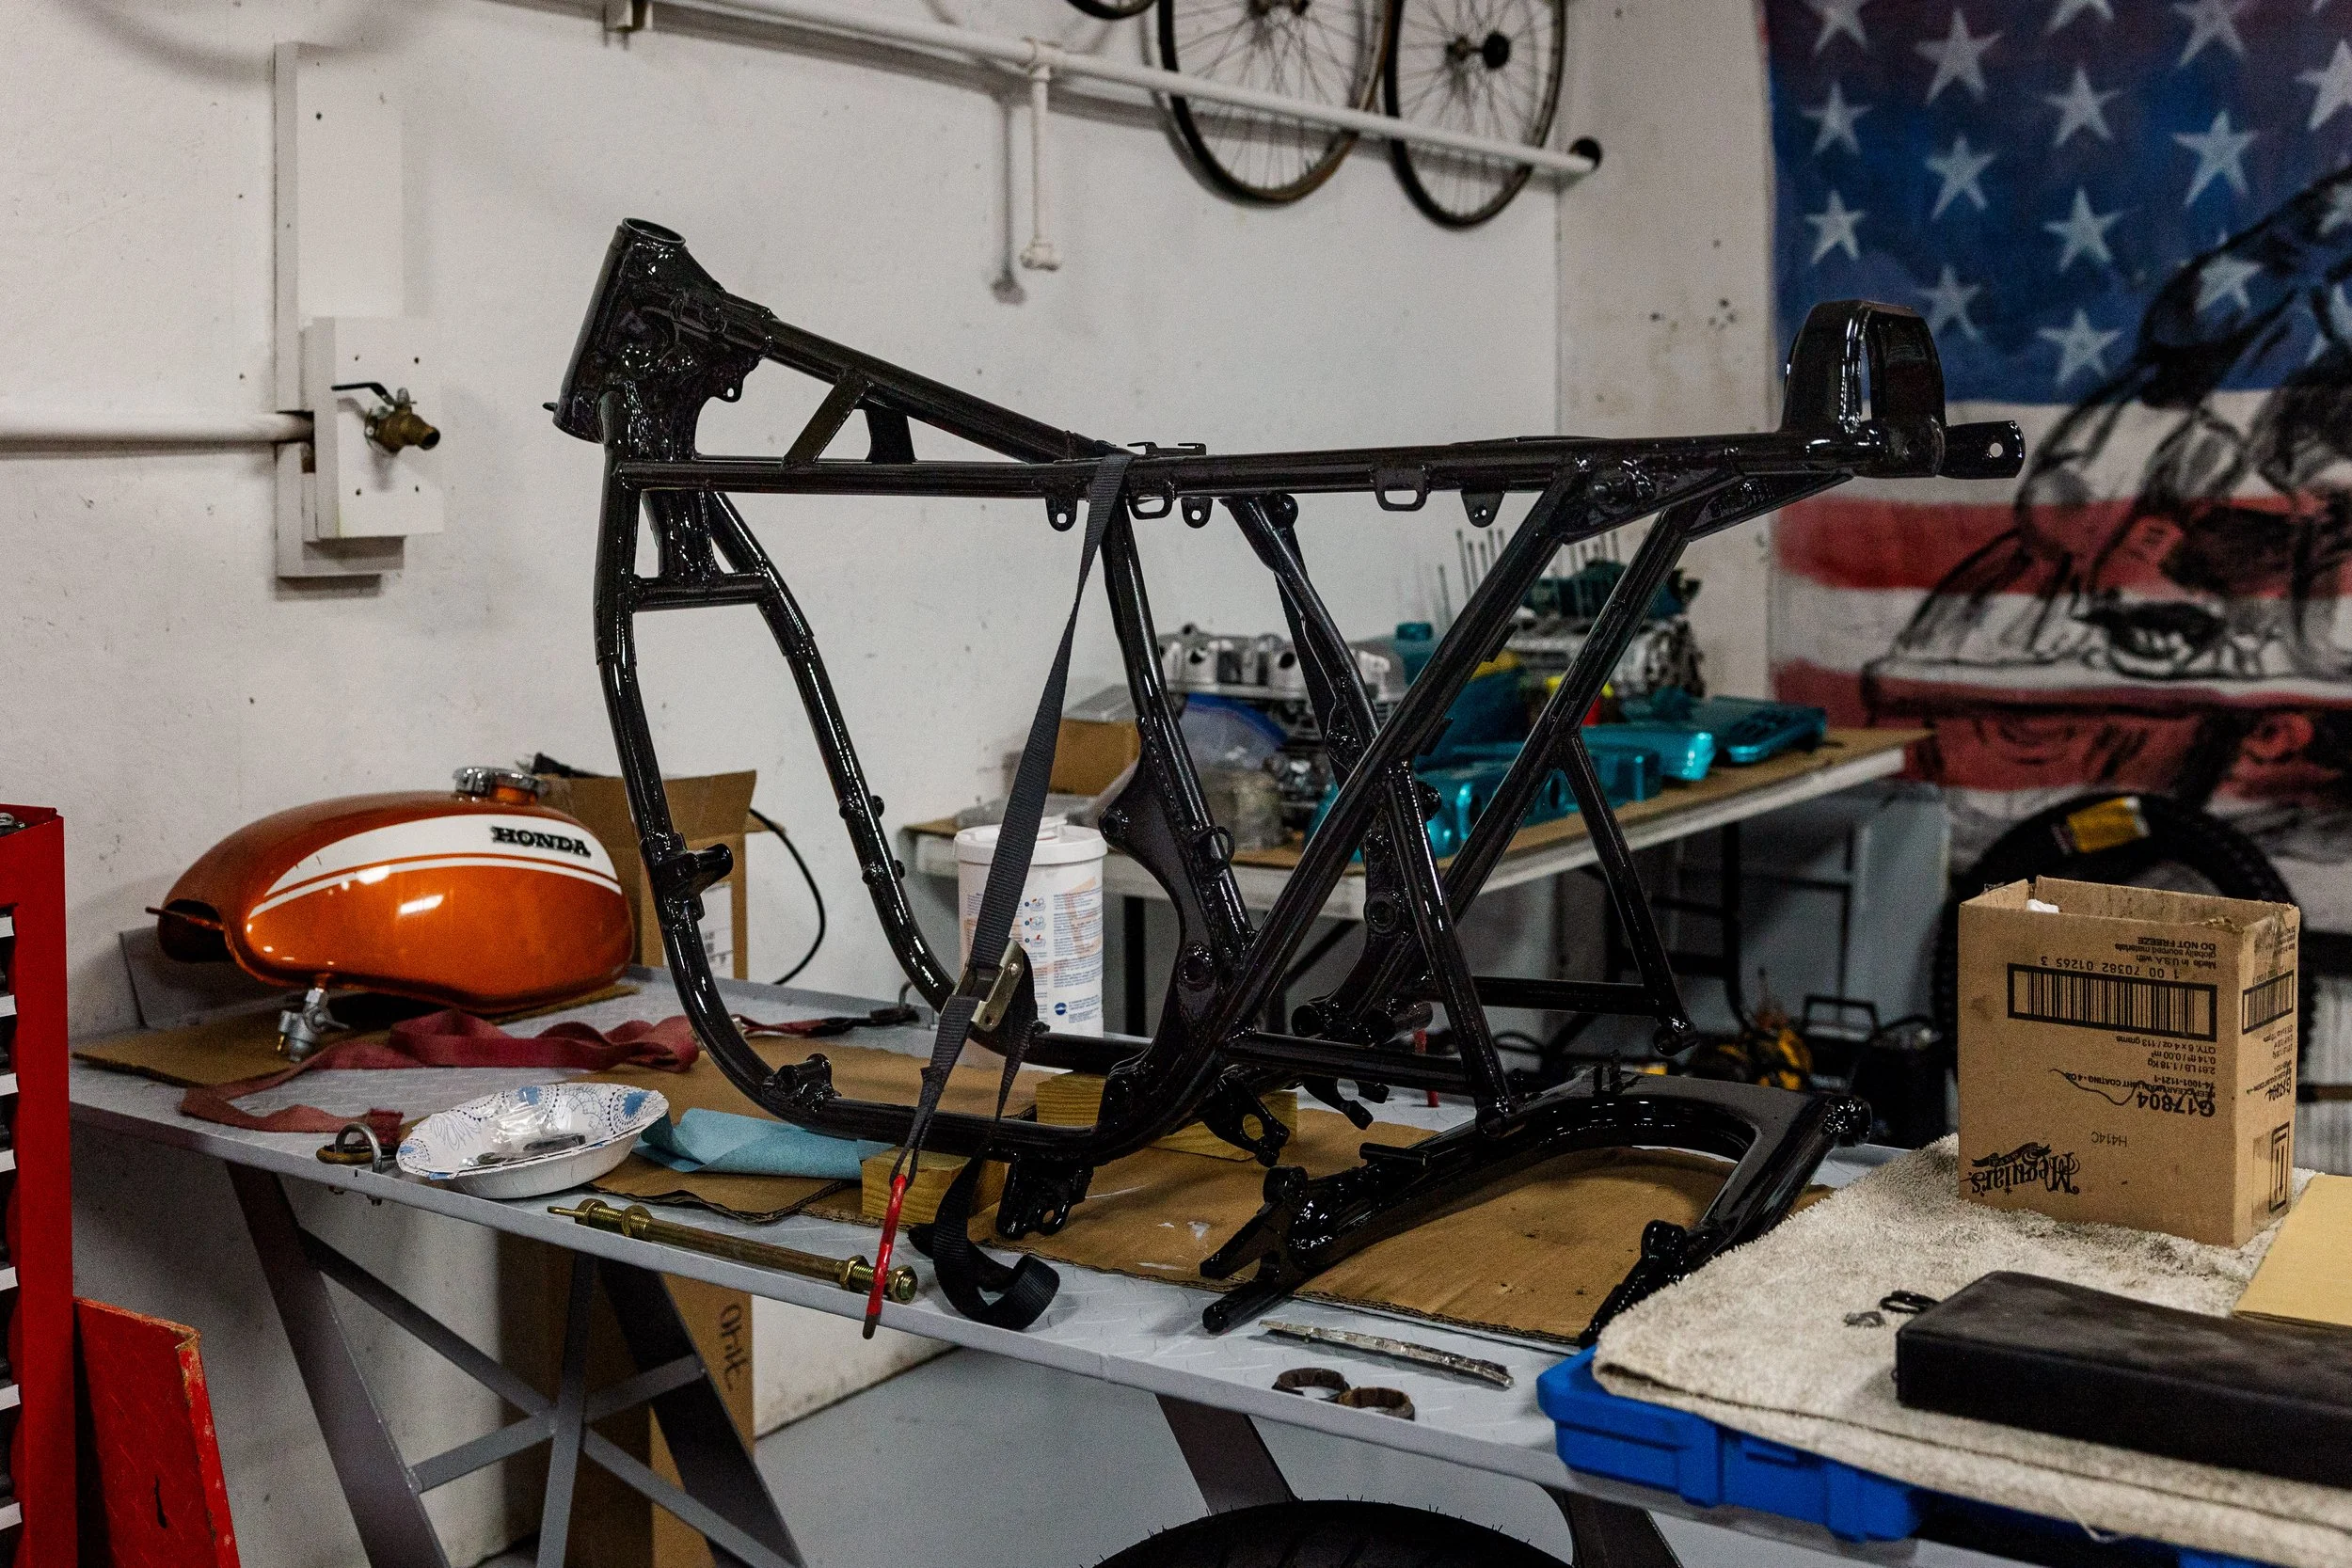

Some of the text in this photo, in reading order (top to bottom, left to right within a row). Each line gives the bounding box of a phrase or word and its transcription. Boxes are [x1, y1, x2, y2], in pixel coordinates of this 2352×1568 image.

[492, 827, 591, 858] HONDA
[2137, 937, 2174, 947] FREEZE
[2115, 943, 2216, 958] globally sourced materials
[2137, 955, 2152, 963] with
[2194, 959, 2217, 969] Made
[2041, 956, 2179, 979] 1 00 70382 01265 3
[2117, 1037, 2140, 1045] grams
[2142, 1039, 2155, 1048] 113
[2164, 1053, 2181, 1061] 0.00
[2148, 1059, 2158, 1068] Kg
[2185, 1064, 2196, 1072] LB
[2089, 1075, 2121, 1086] COATING
[2167, 1086, 2192, 1095] CLEAR
[2137, 1092, 2216, 1117] G17804
[2090, 1132, 2127, 1147] H414C
